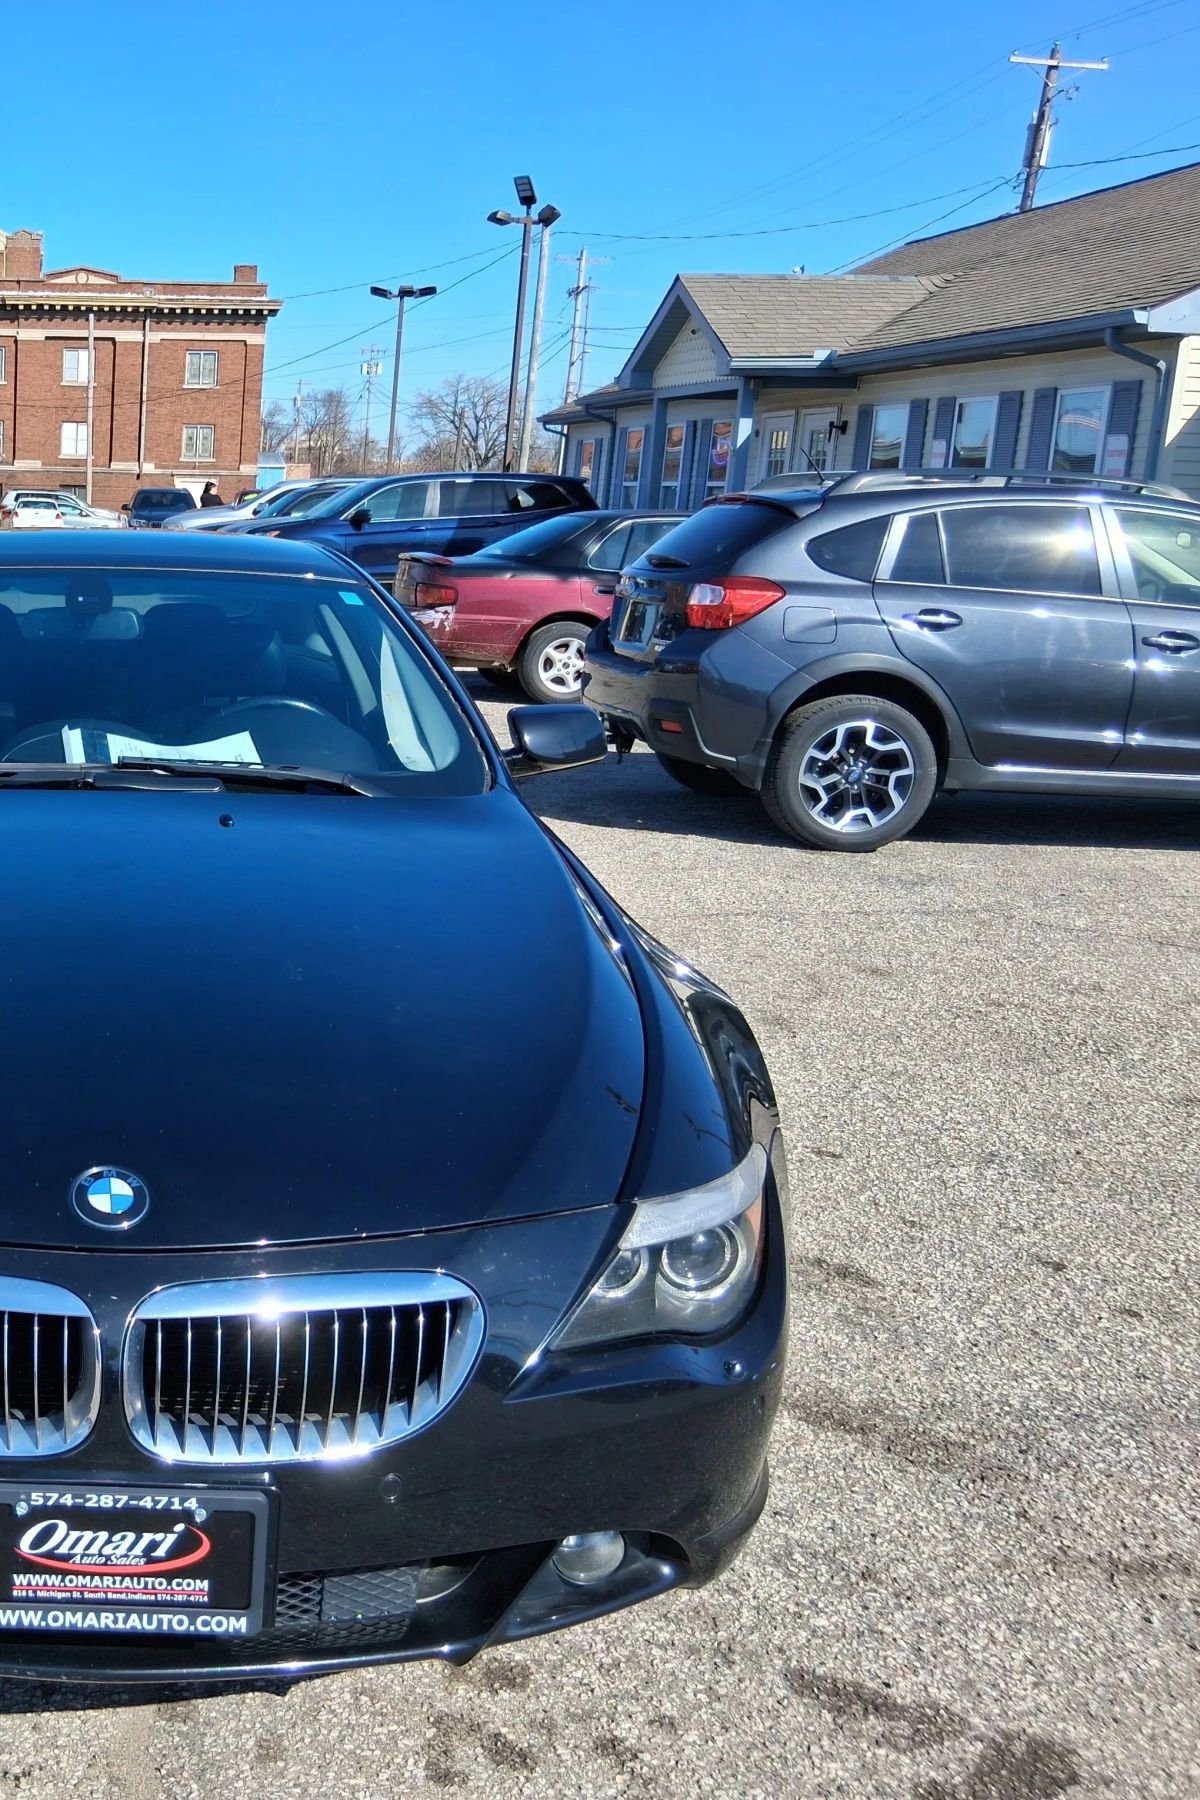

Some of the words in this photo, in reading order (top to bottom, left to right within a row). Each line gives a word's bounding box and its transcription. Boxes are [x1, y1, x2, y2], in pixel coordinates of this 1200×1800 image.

[30, 1492, 199, 1510] 574-287-4714
[18, 1519, 186, 1557] Omari
[68, 1553, 106, 1565] Auto
[106, 1554, 147, 1566] Sales
[12, 1574, 209, 1591] WWW.OMARIAUTO.COM
[36, 1590, 71, 1599] Michigan
[83, 1591, 106, 1599] South
